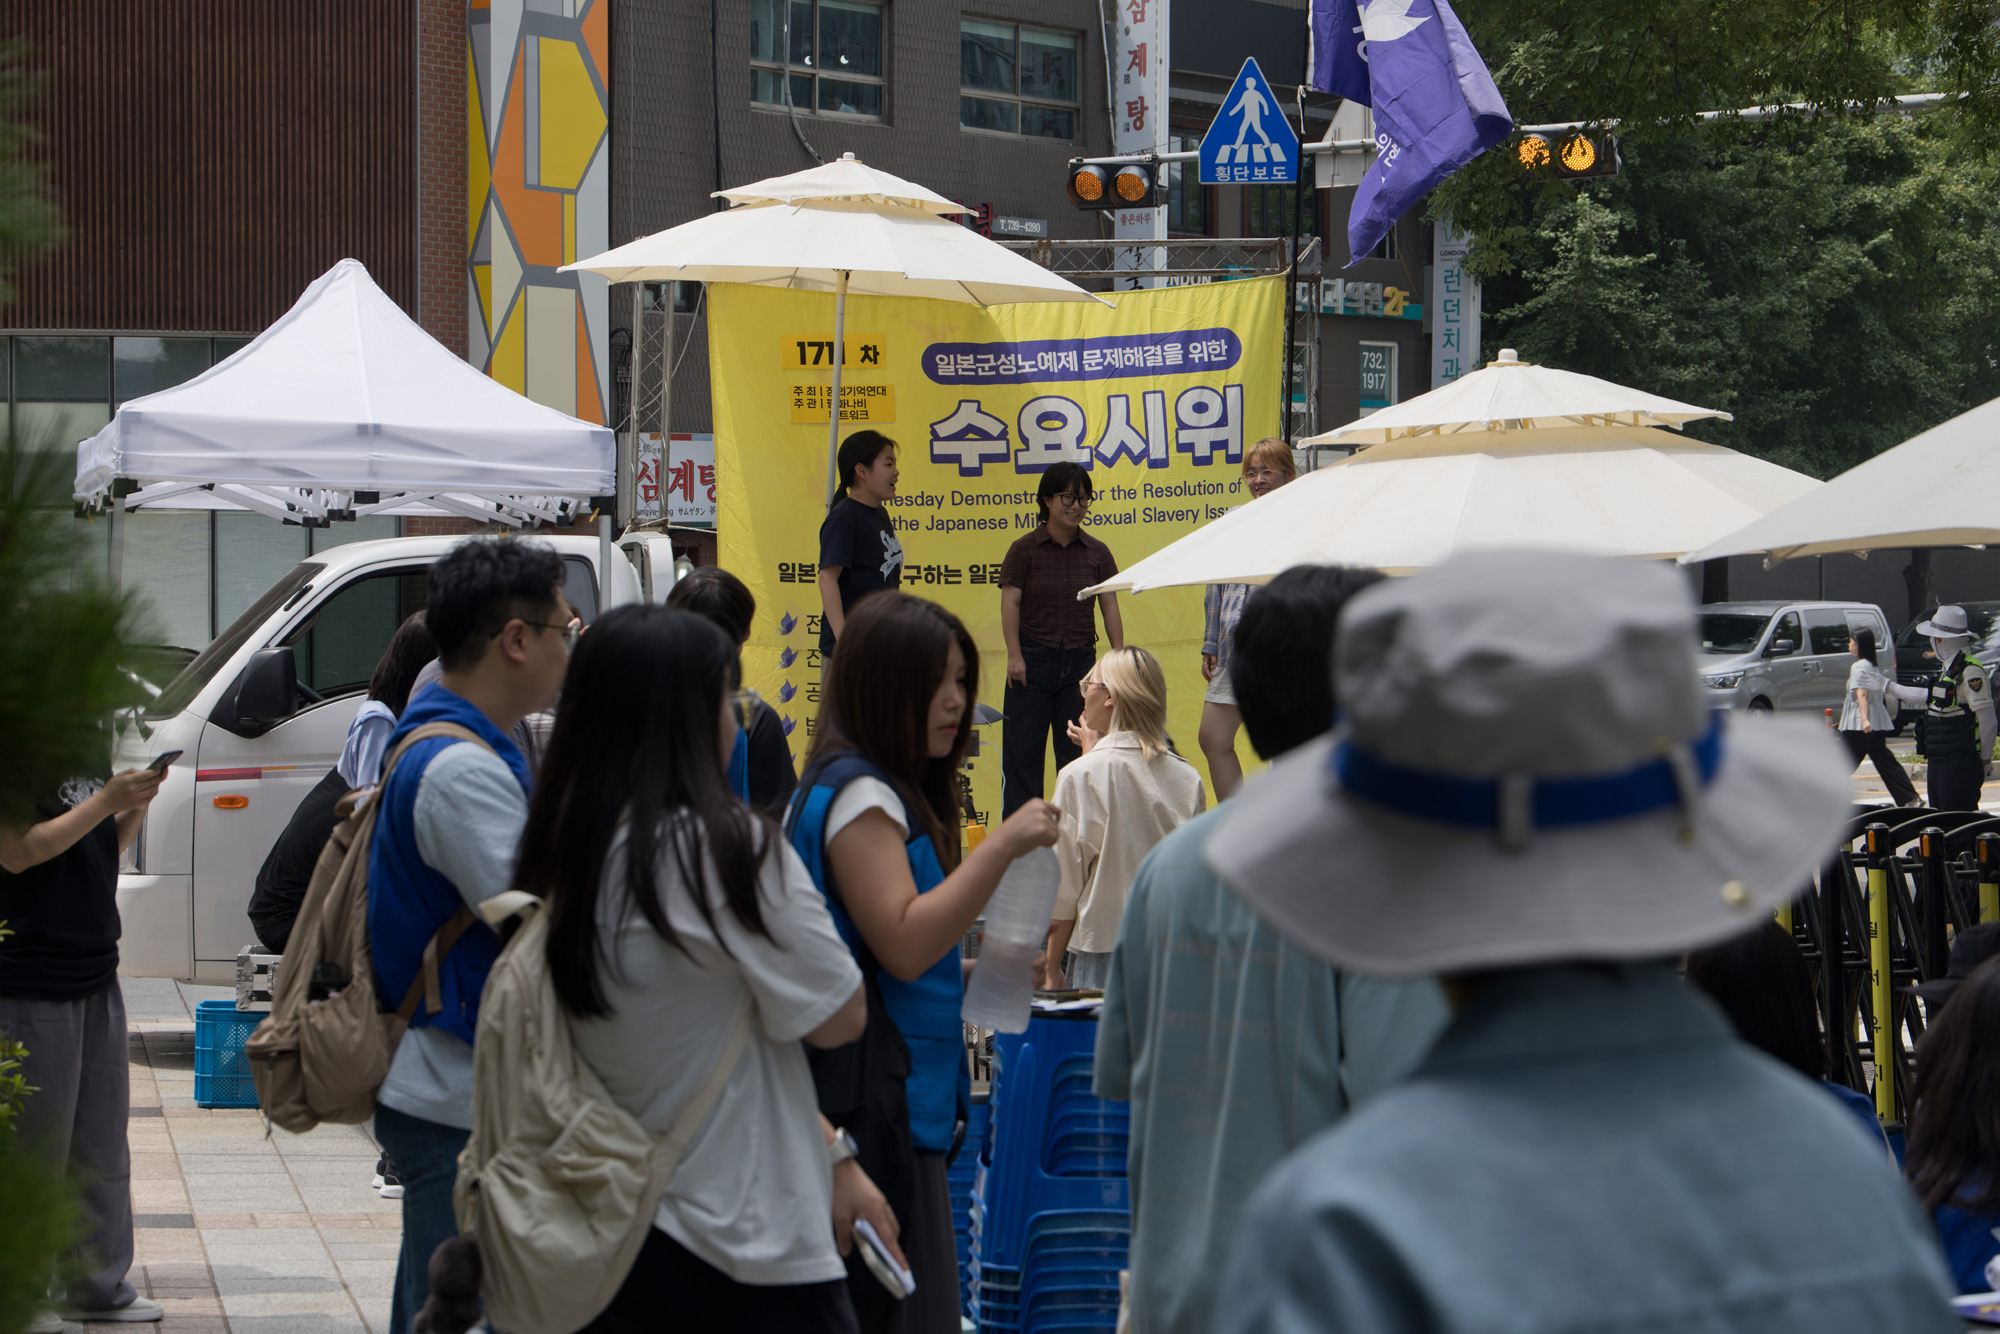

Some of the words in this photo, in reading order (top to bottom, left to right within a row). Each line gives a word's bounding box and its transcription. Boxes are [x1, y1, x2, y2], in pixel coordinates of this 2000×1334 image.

[1215, 165, 1288, 182] 횡단보도
[1120, 213, 1152, 226] 좋은하루
[1384, 286, 1410, 317] 2F
[1442, 268, 1461, 379] 런던치과
[860, 344, 880, 365] 차
[935, 350, 1078, 377] 일본군성노예제
[1082, 342, 1184, 372] 문제해결을
[1188, 339, 1228, 363] 위한
[1363, 373, 1386, 390] 1917
[829, 410, 869, 420] 트워크
[929, 383, 1244, 478] 수요시위
[1110, 484, 1137, 500] the
[1143, 480, 1226, 499] Resolution
[1228, 477, 1242, 494] of
[891, 515, 919, 531] the
[925, 513, 1008, 534] Japanese
[1082, 508, 1136, 527] Sexual
[1142, 506, 1200, 525] Slavery
[778, 562, 820, 584] 일본
[899, 564, 962, 586] 구하는
